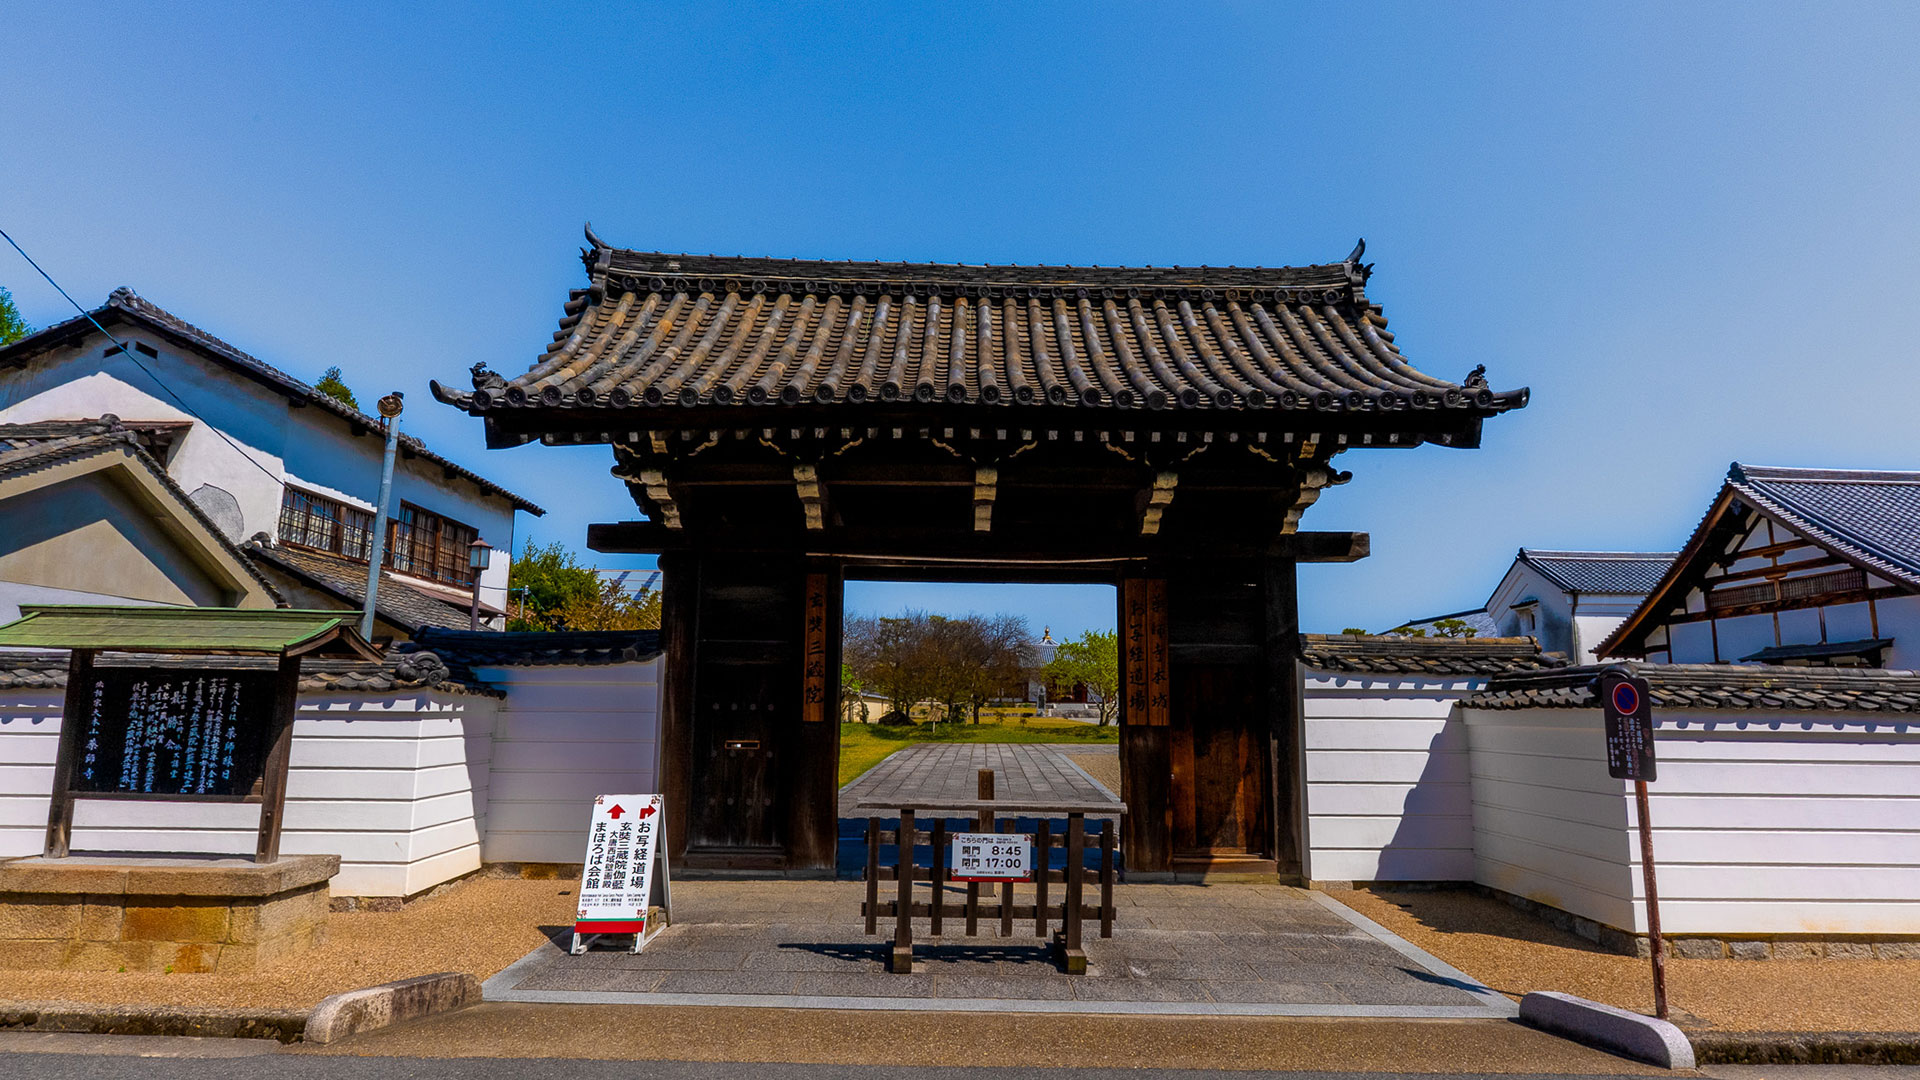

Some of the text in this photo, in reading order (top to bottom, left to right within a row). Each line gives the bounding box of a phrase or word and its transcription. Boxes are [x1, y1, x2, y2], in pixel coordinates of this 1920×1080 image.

[1129, 600, 1146, 711] お写経道場
[585, 822, 607, 889] まほろば会館
[602, 831, 619, 889] 大唐西域壁画殿
[611, 822, 632, 889] 玄奘三蔵院伽藍
[630, 821, 651, 889] お写経道場
[961, 858, 1021, 868] 閉門 17:00
[962, 846, 1021, 856] 開門 8:45
